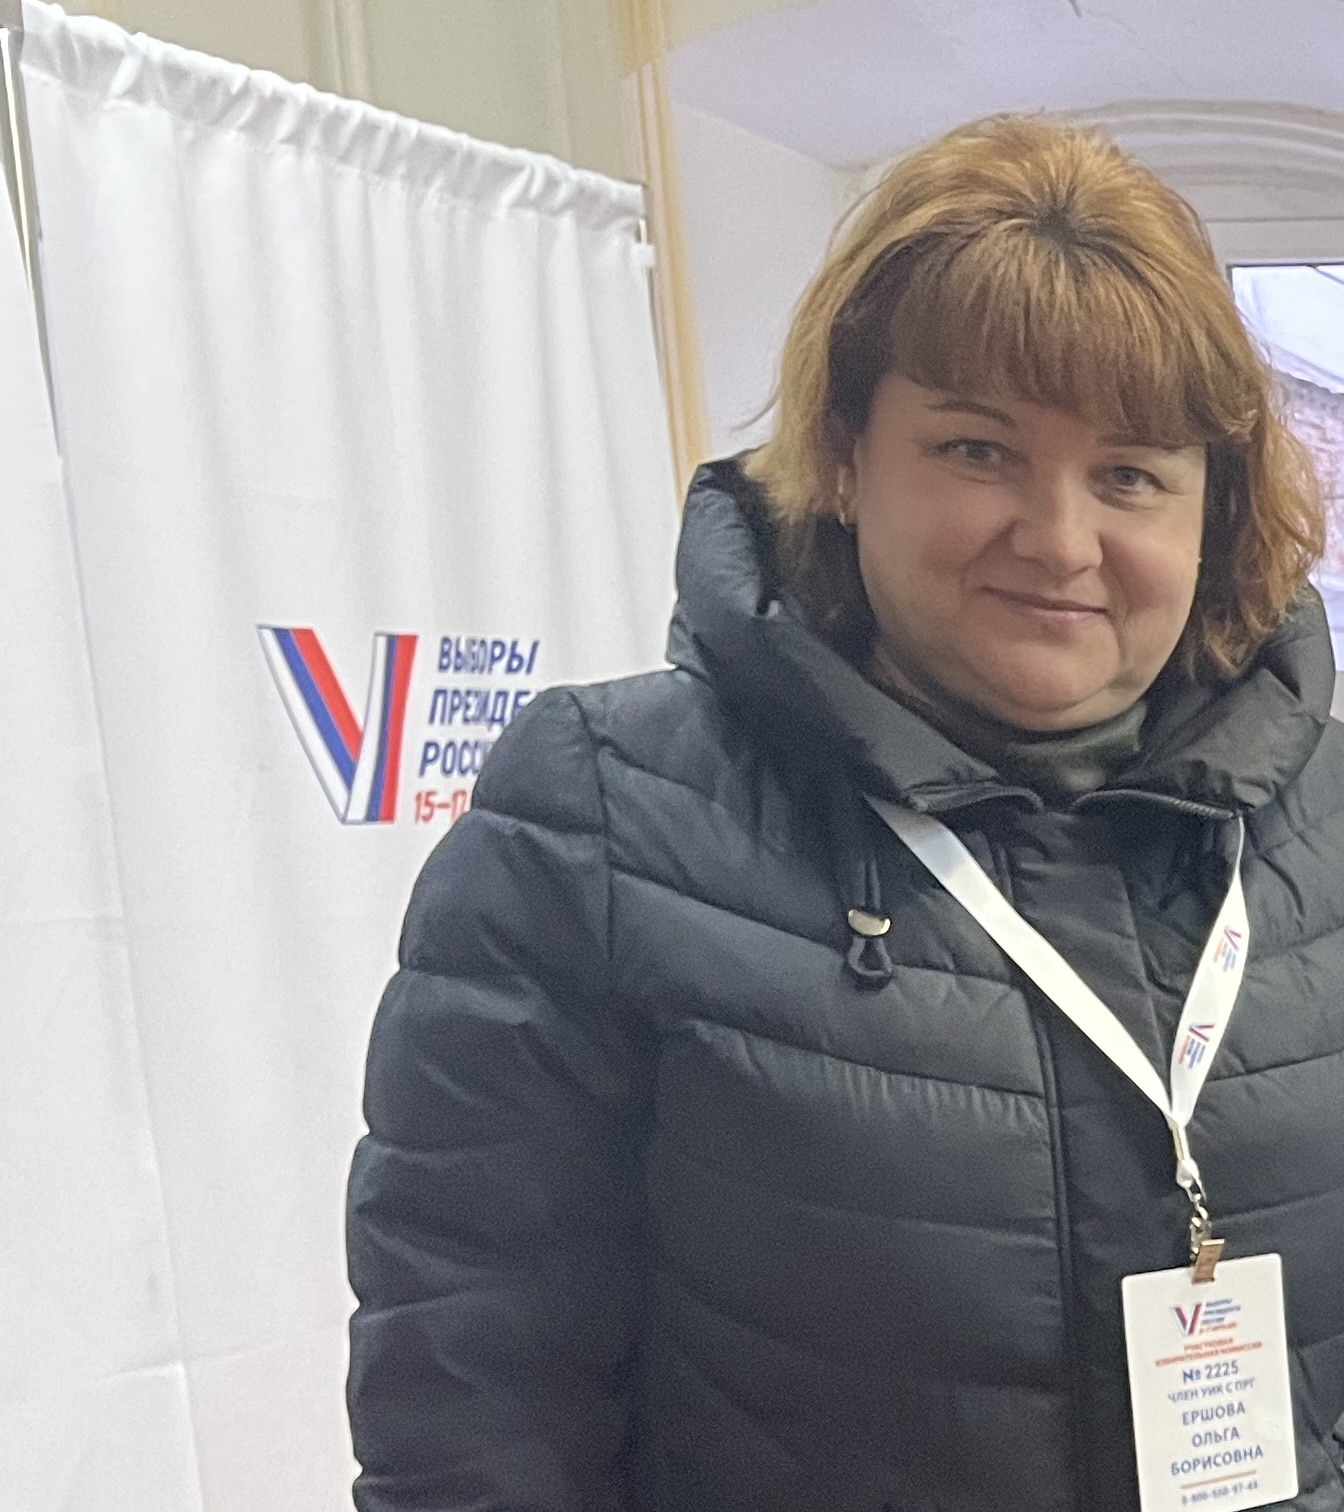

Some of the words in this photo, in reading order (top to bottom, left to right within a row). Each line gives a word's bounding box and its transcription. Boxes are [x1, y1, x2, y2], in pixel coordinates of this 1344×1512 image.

[438, 636, 540, 675] ВЫБОРЫ
[1182, 1369, 1201, 1384] №
[1205, 1360, 1239, 1379] 2225
[1168, 1389, 1198, 1403] ЧЛЕН
[1200, 1384, 1223, 1398] УИК
[1226, 1381, 1233, 1393] С
[1235, 1377, 1255, 1391] ПРГ
[1182, 1401, 1245, 1426] ЕРШОВА
[1192, 1426, 1240, 1447] ОЛЬГА
[1171, 1445, 1263, 1476] БОРИСОВНА
